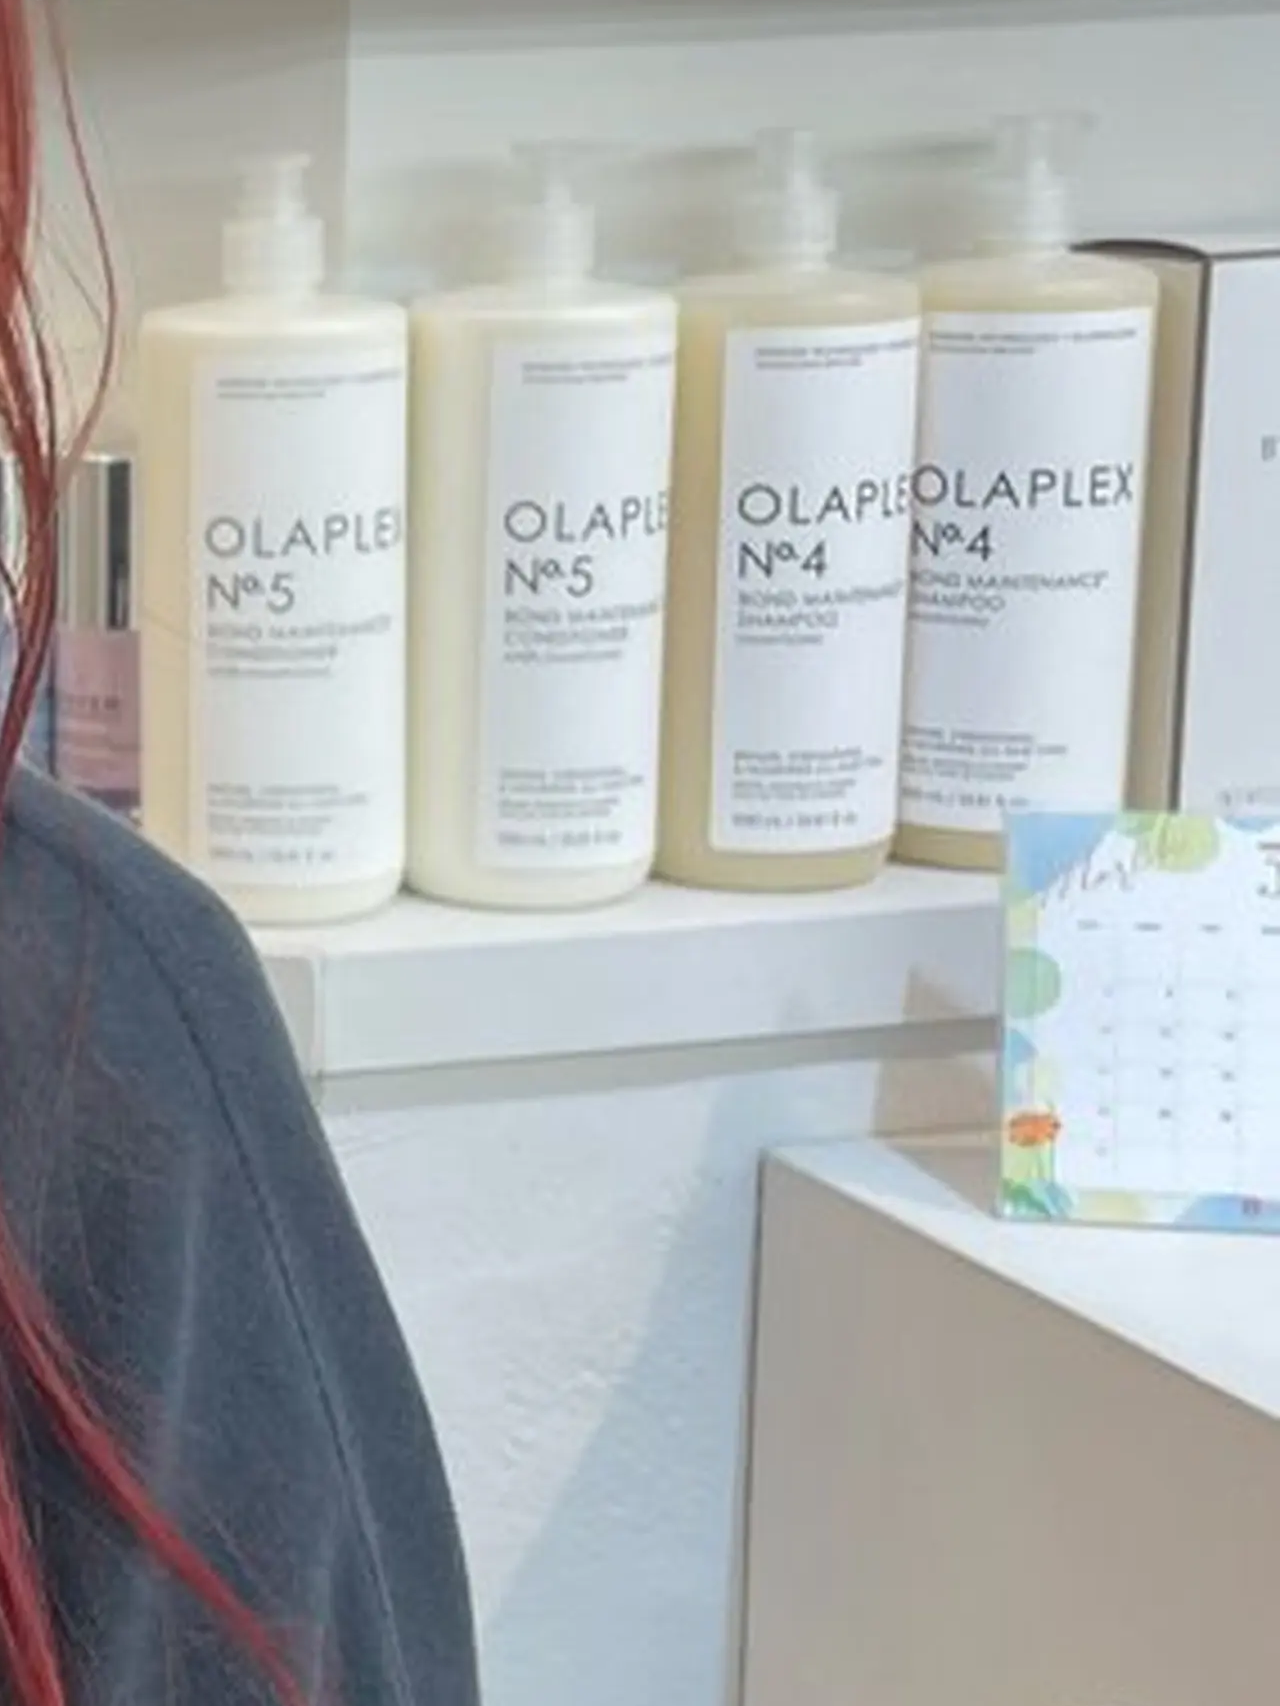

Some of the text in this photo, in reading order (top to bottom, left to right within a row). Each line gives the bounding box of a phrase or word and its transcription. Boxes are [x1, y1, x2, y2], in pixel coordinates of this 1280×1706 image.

[737, 473, 908, 528] OLAPLE
[911, 462, 1134, 511] OLAPLEX
[503, 490, 667, 543] OLAPLE
